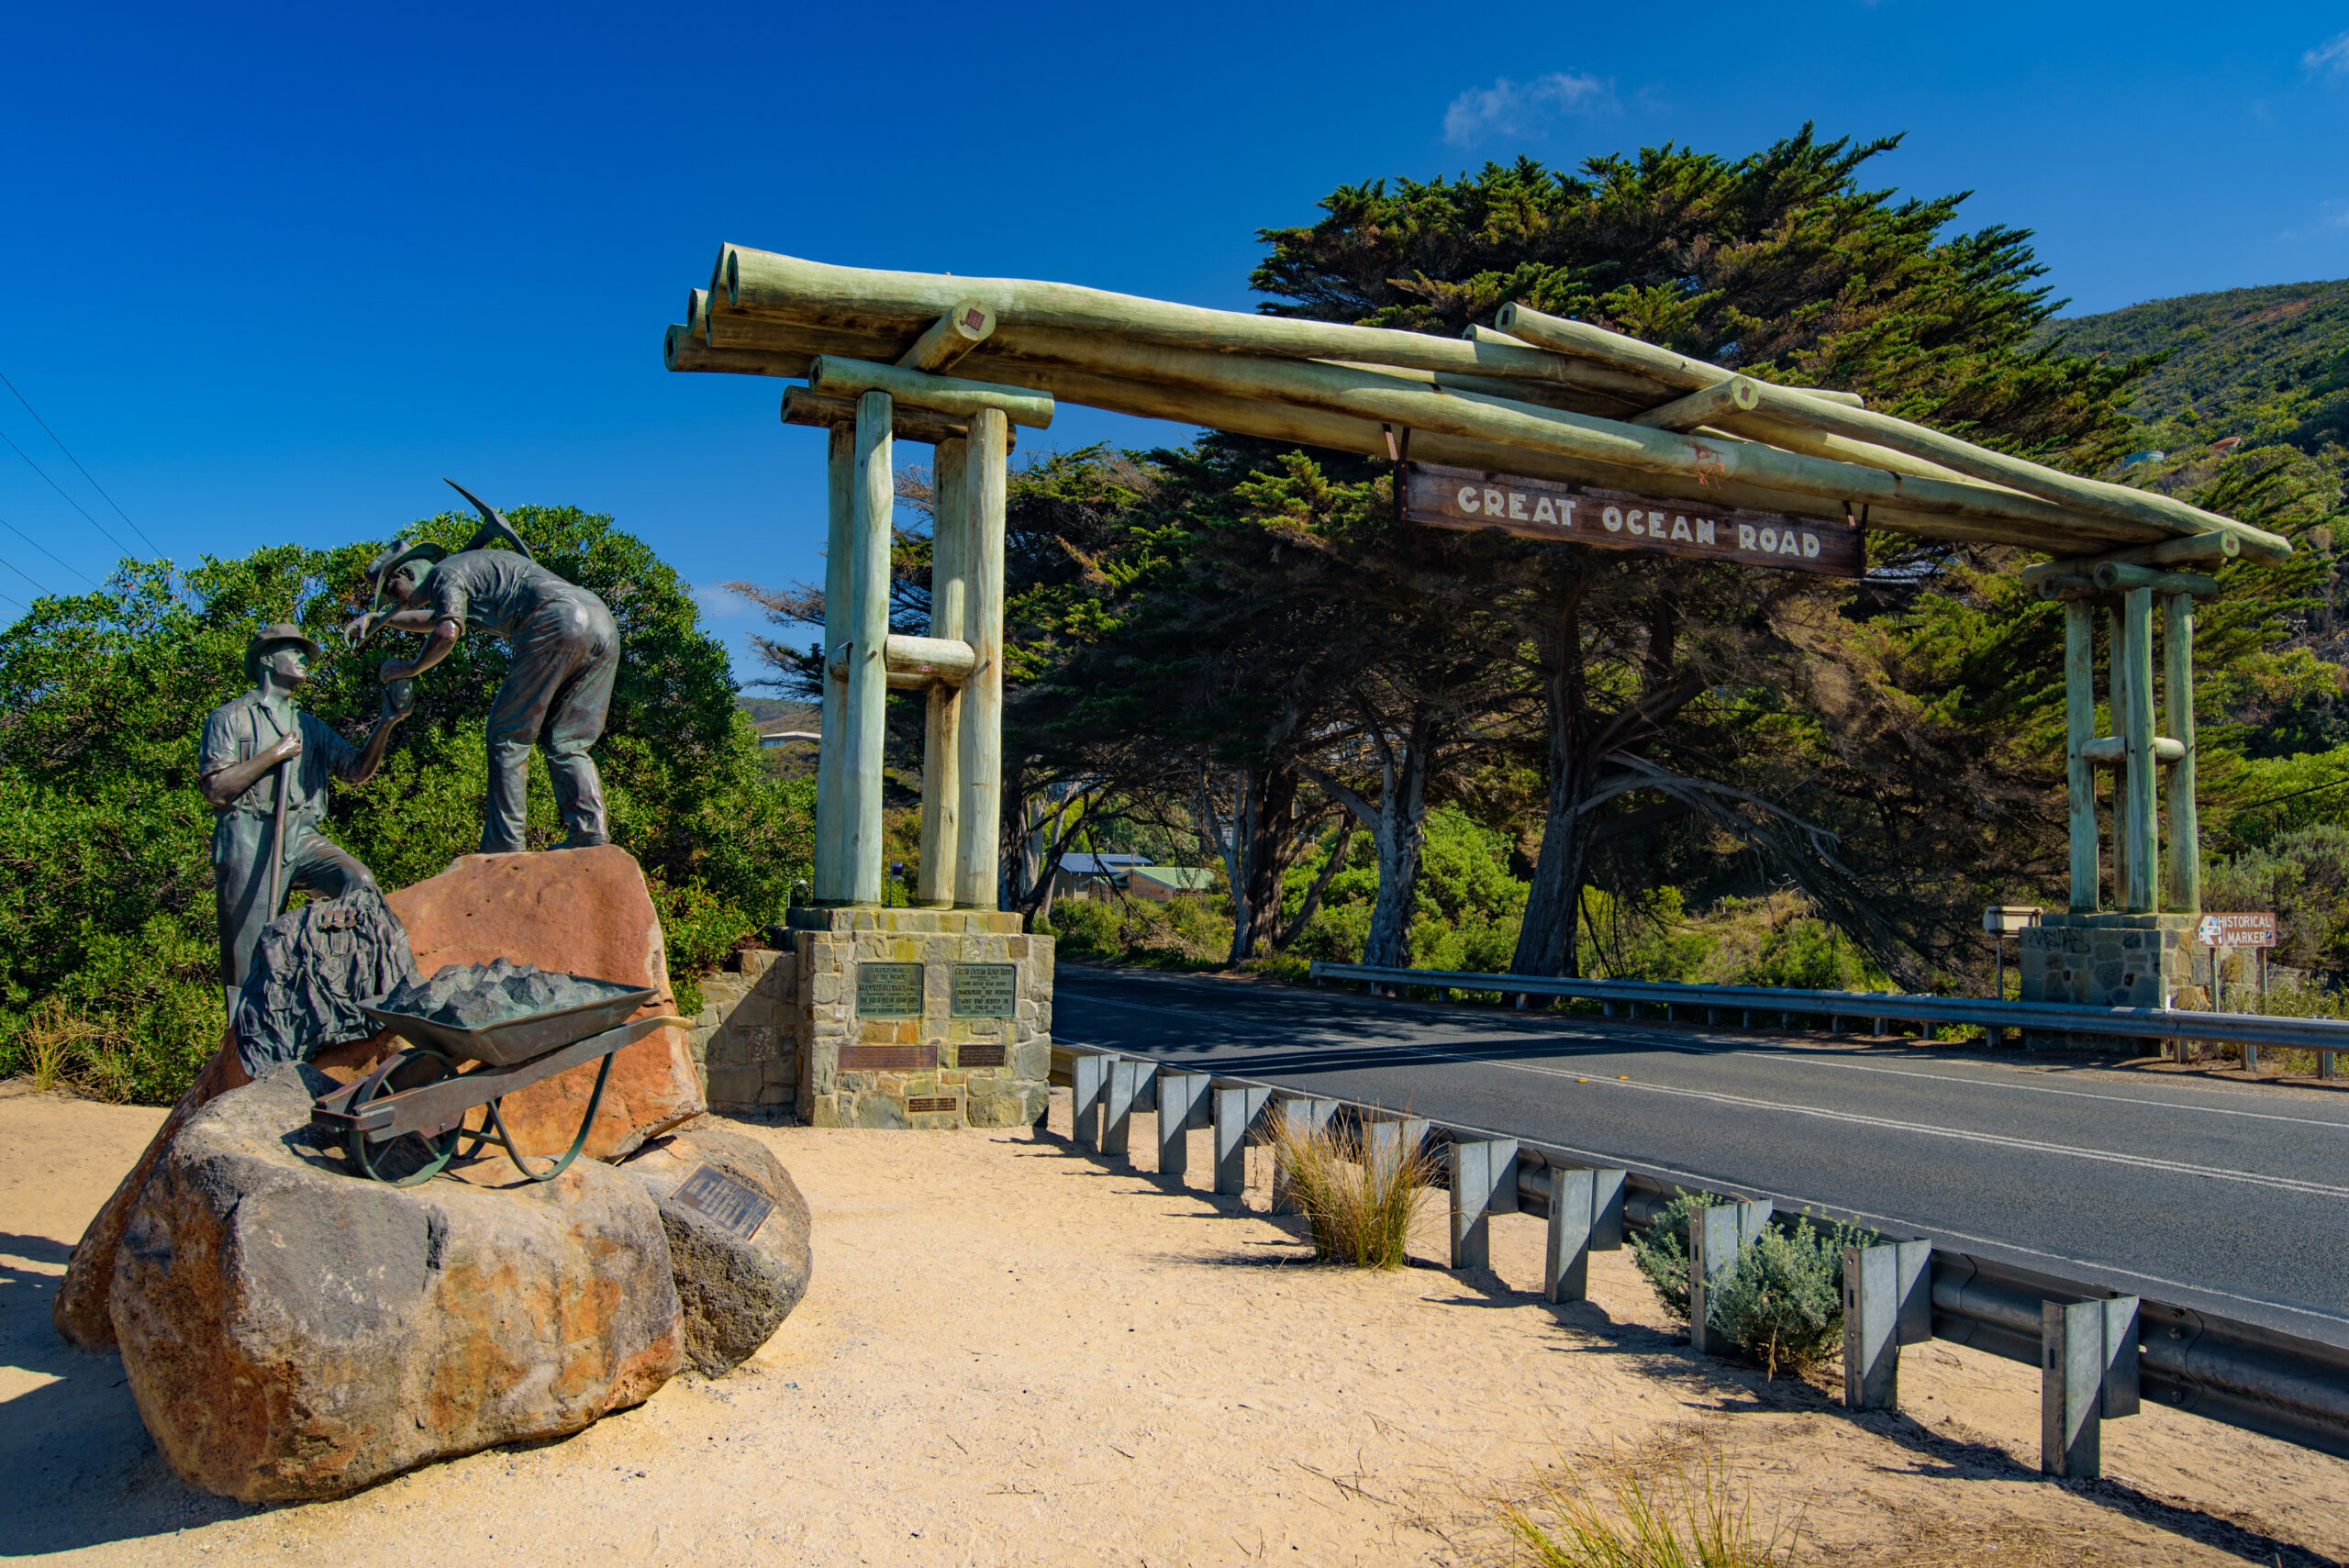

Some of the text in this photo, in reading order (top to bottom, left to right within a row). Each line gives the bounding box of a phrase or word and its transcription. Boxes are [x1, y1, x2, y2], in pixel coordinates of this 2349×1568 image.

[1457, 486, 1820, 559] GREAT OCEAN ROAD
[2218, 915, 2271, 928] HISTORICAL
[2227, 930, 2266, 944] MARKER
